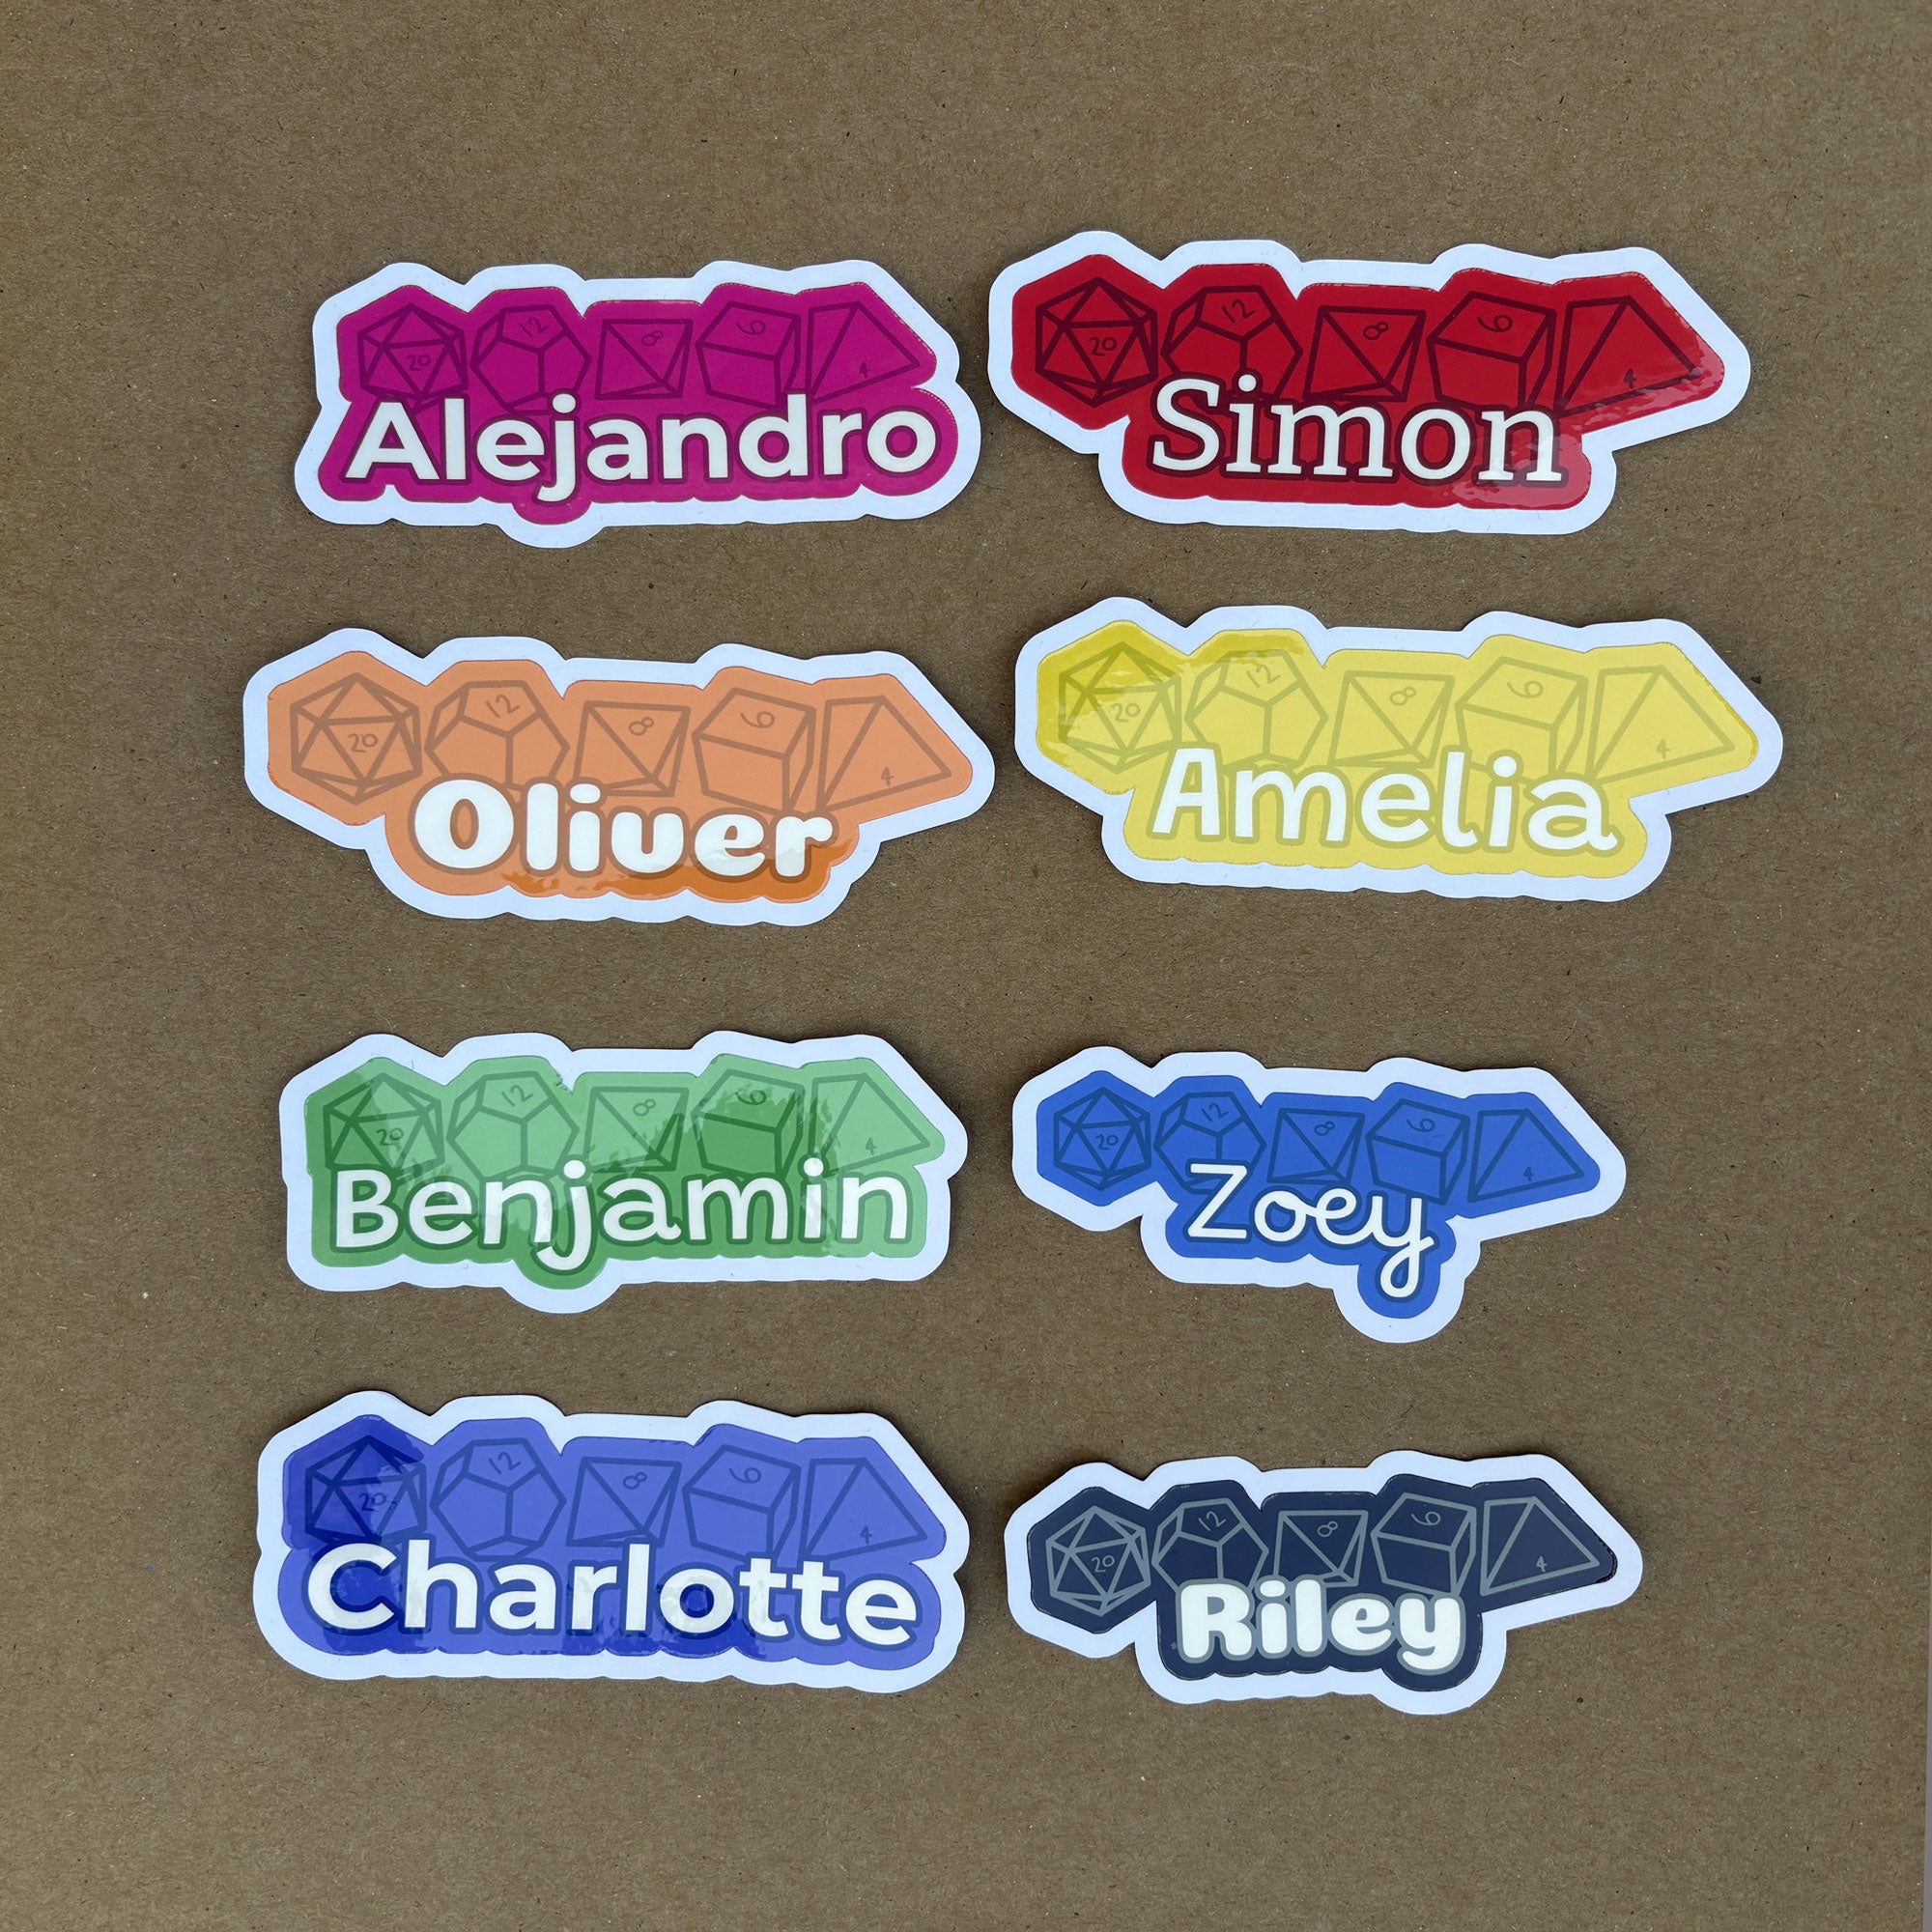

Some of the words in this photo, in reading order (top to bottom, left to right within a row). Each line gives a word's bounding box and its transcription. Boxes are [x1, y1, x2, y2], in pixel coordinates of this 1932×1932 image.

[1221, 298, 1255, 324] 12
[520, 318, 550, 337] 12
[735, 320, 767, 336] 6
[1362, 321, 1389, 342] 8
[1477, 314, 1513, 333] 6
[640, 330, 664, 348] 8
[1088, 335, 1119, 357] 20
[405, 352, 432, 372] 20
[858, 360, 870, 378] 4
[1622, 367, 1637, 388] 4
[1151, 373, 1563, 482] Simon
[345, 392, 937, 503] Alejandro
[1245, 664, 1280, 688] 12
[1388, 685, 1416, 705] 8
[1507, 680, 1544, 698] 6
[485, 694, 519, 717] 12
[1112, 700, 1141, 723] 20
[629, 717, 655, 736] 8
[740, 710, 776, 728] 6
[348, 731, 379, 753] 20
[1656, 740, 1670, 760] 4
[879, 766, 895, 787] 4
[1151, 747, 1619, 852] Amelia
[412, 778, 835, 878] Oliver
[501, 1084, 531, 1106] 12
[735, 1090, 767, 1107] 6
[633, 1098, 657, 1117] 8
[1201, 1102, 1228, 1122] 12
[1313, 1121, 1336, 1137] 8
[1406, 1118, 1435, 1133] 6
[376, 1126, 405, 1147] 20
[865, 1136, 878, 1155] 4
[1095, 1133, 1120, 1151] 20
[1521, 1166, 1534, 1182] 4
[335, 1156, 909, 1273] Benjamin
[1186, 1162, 1435, 1299] Zoey
[488, 1451, 521, 1474] 12
[622, 1471, 647, 1491] 8
[727, 1467, 761, 1485] 6
[357, 1491, 387, 1513] 20
[1198, 1511, 1227, 1532] 12
[1410, 1510, 1441, 1525] 6
[859, 1524, 874, 1544] 4
[1317, 1520, 1338, 1538] 8
[1090, 1554, 1116, 1574] 20
[1535, 1556, 1548, 1573] 4
[307, 1538, 918, 1646] Charlotte
[1179, 1578, 1463, 1671] Riley
